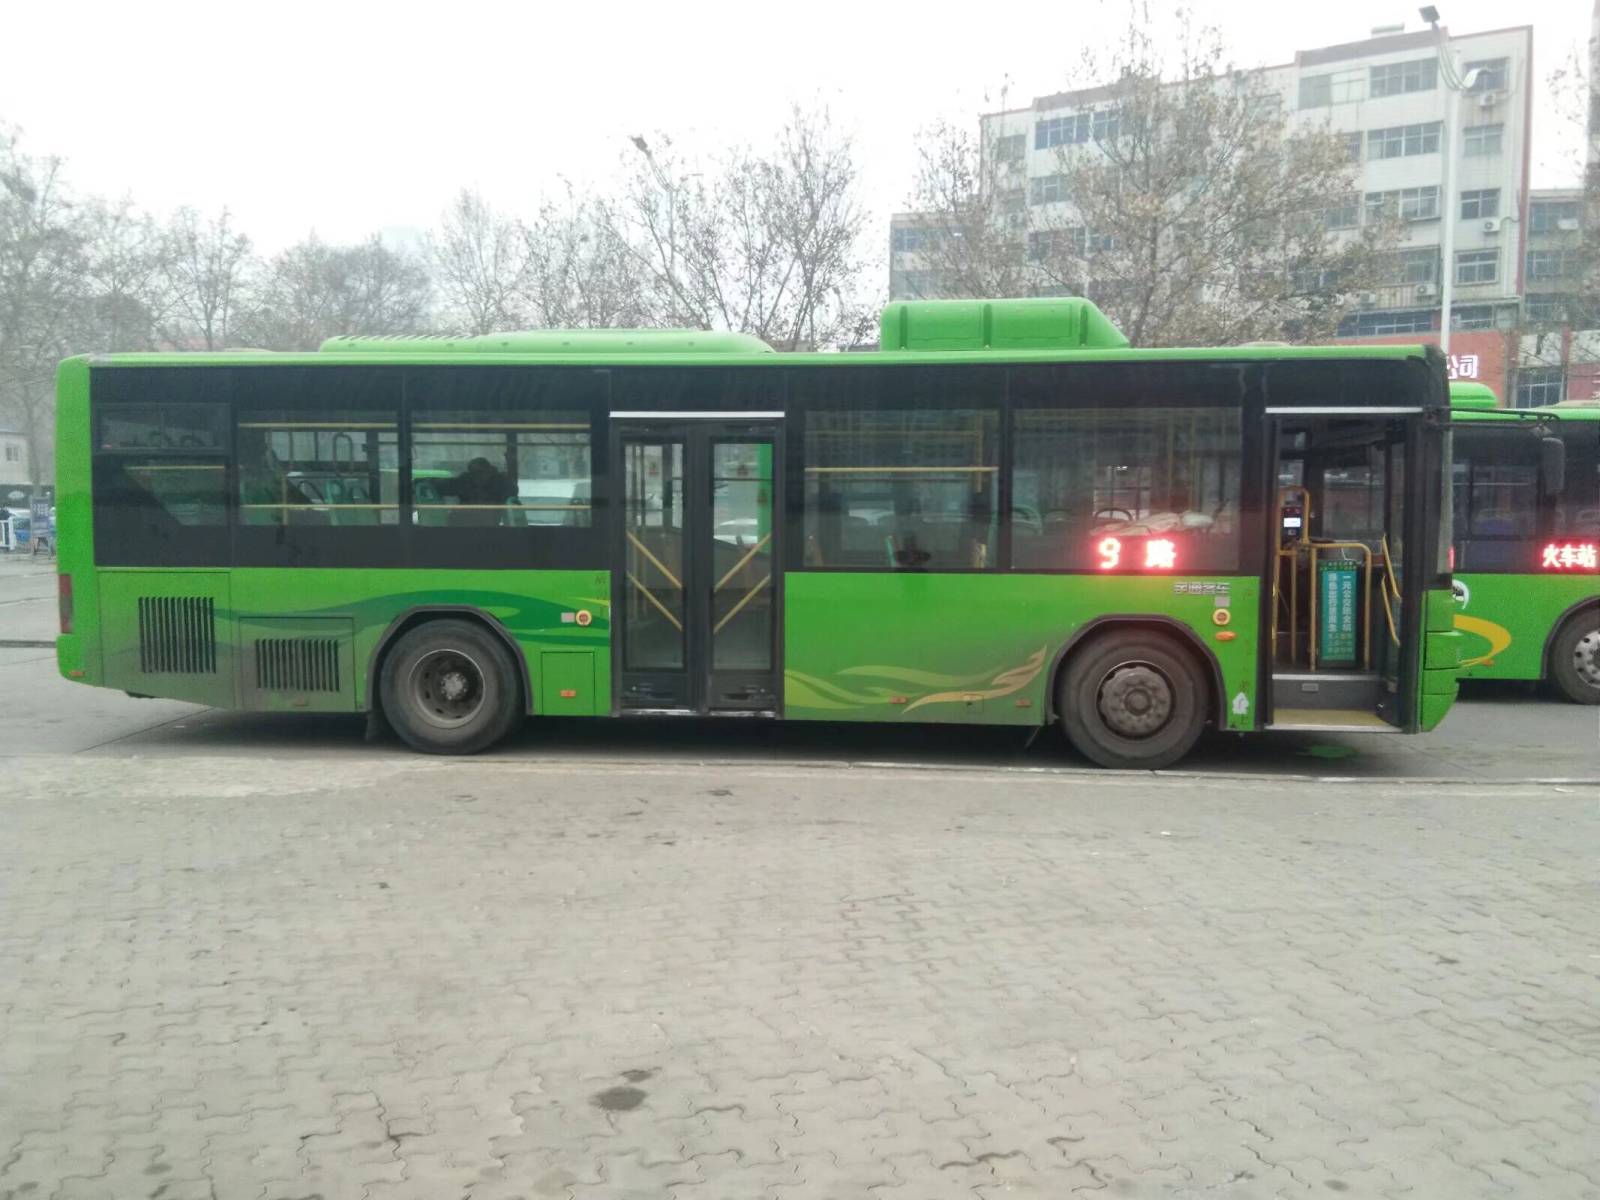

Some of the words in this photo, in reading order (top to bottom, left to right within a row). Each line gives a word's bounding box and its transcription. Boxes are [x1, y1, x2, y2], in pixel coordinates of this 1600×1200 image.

[1098, 537, 1121, 569] 9
[1542, 544, 1597, 568] 火车站
